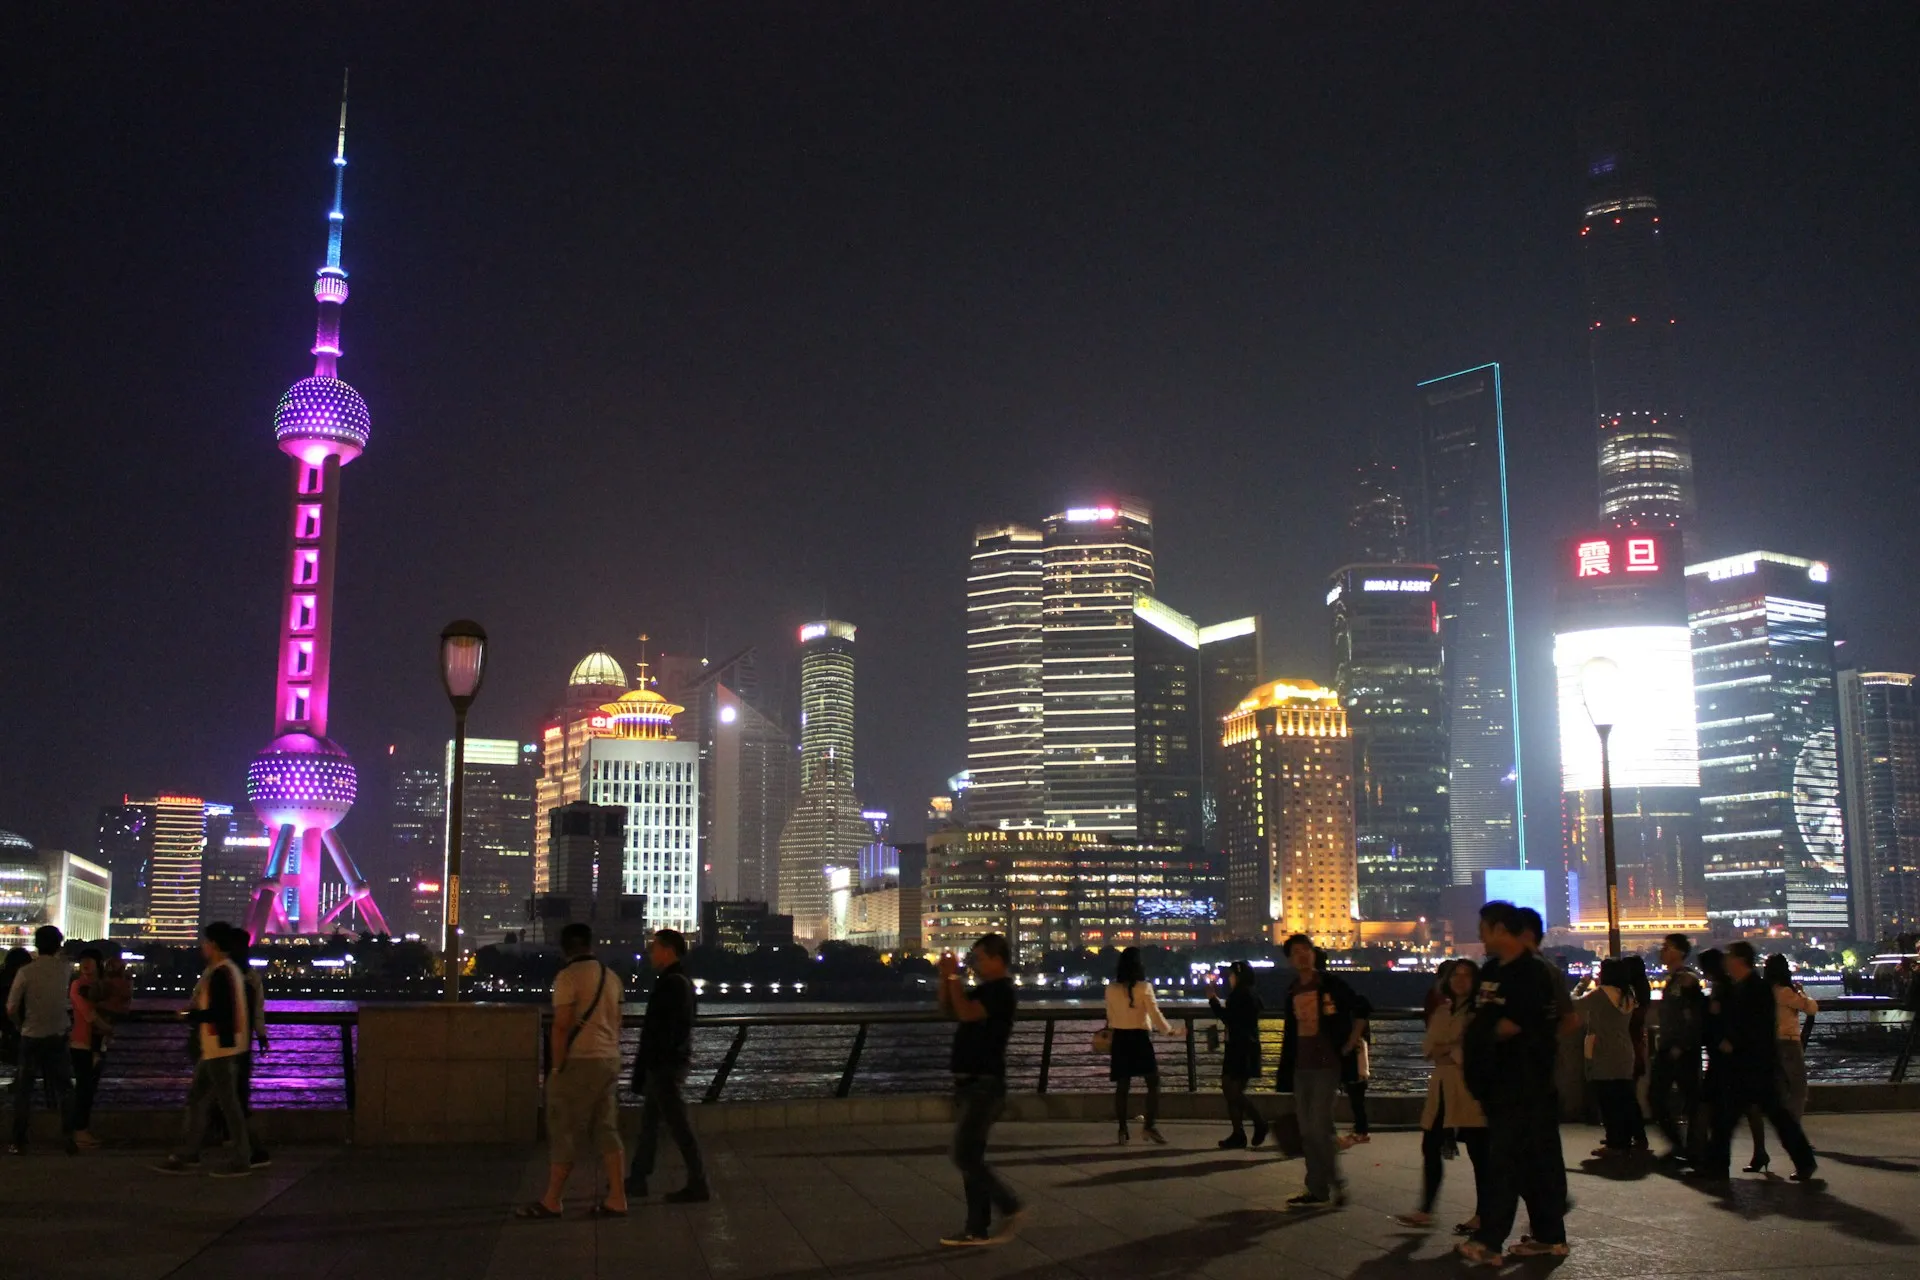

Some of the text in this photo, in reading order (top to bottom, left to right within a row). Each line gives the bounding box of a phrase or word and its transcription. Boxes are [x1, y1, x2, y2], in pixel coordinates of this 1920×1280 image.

[1578, 539, 1659, 577] 震旦
[1364, 580, 1431, 592] MIRAE ASSET
[967, 832, 1098, 843] SUPER BRAND MALL
